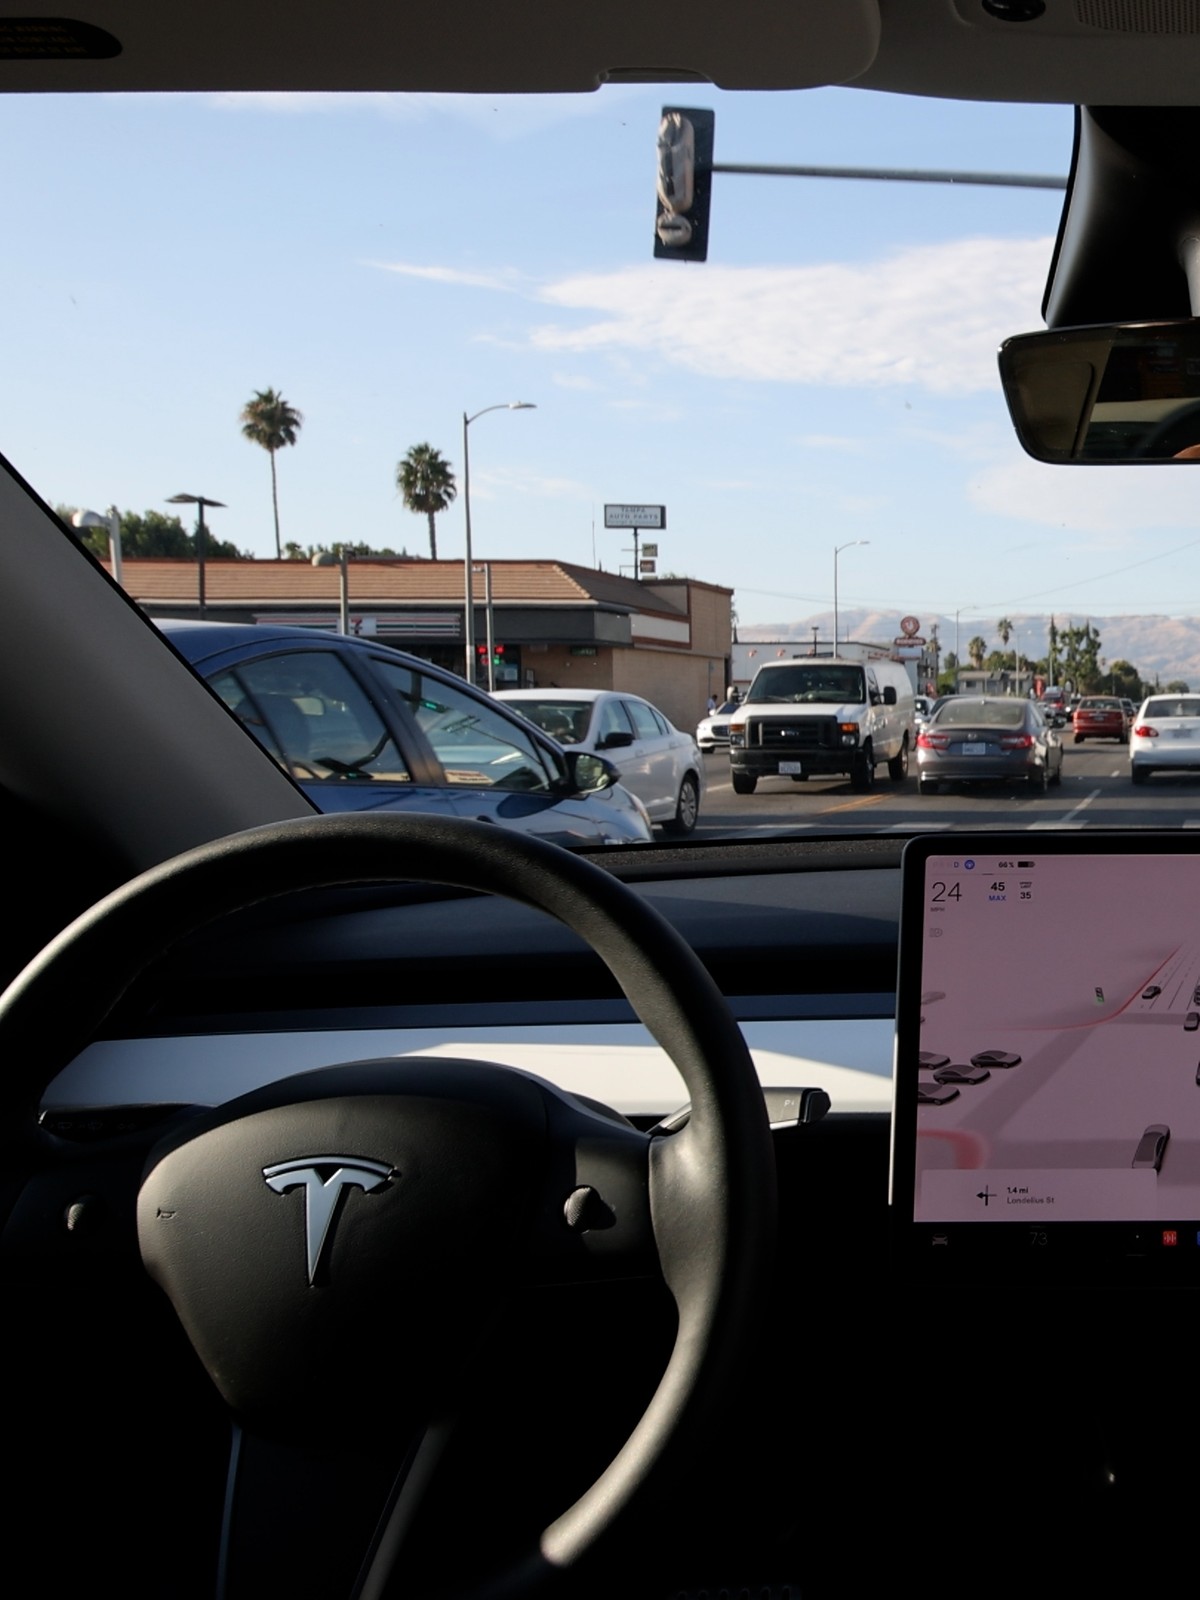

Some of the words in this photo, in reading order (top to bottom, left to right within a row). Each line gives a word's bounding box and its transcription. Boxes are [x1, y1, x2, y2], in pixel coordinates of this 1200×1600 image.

[931, 881, 963, 902] 24
[990, 881, 1005, 892] 45
[1020, 891, 1032, 900] 35
[1019, 1186, 1029, 1194] mi
